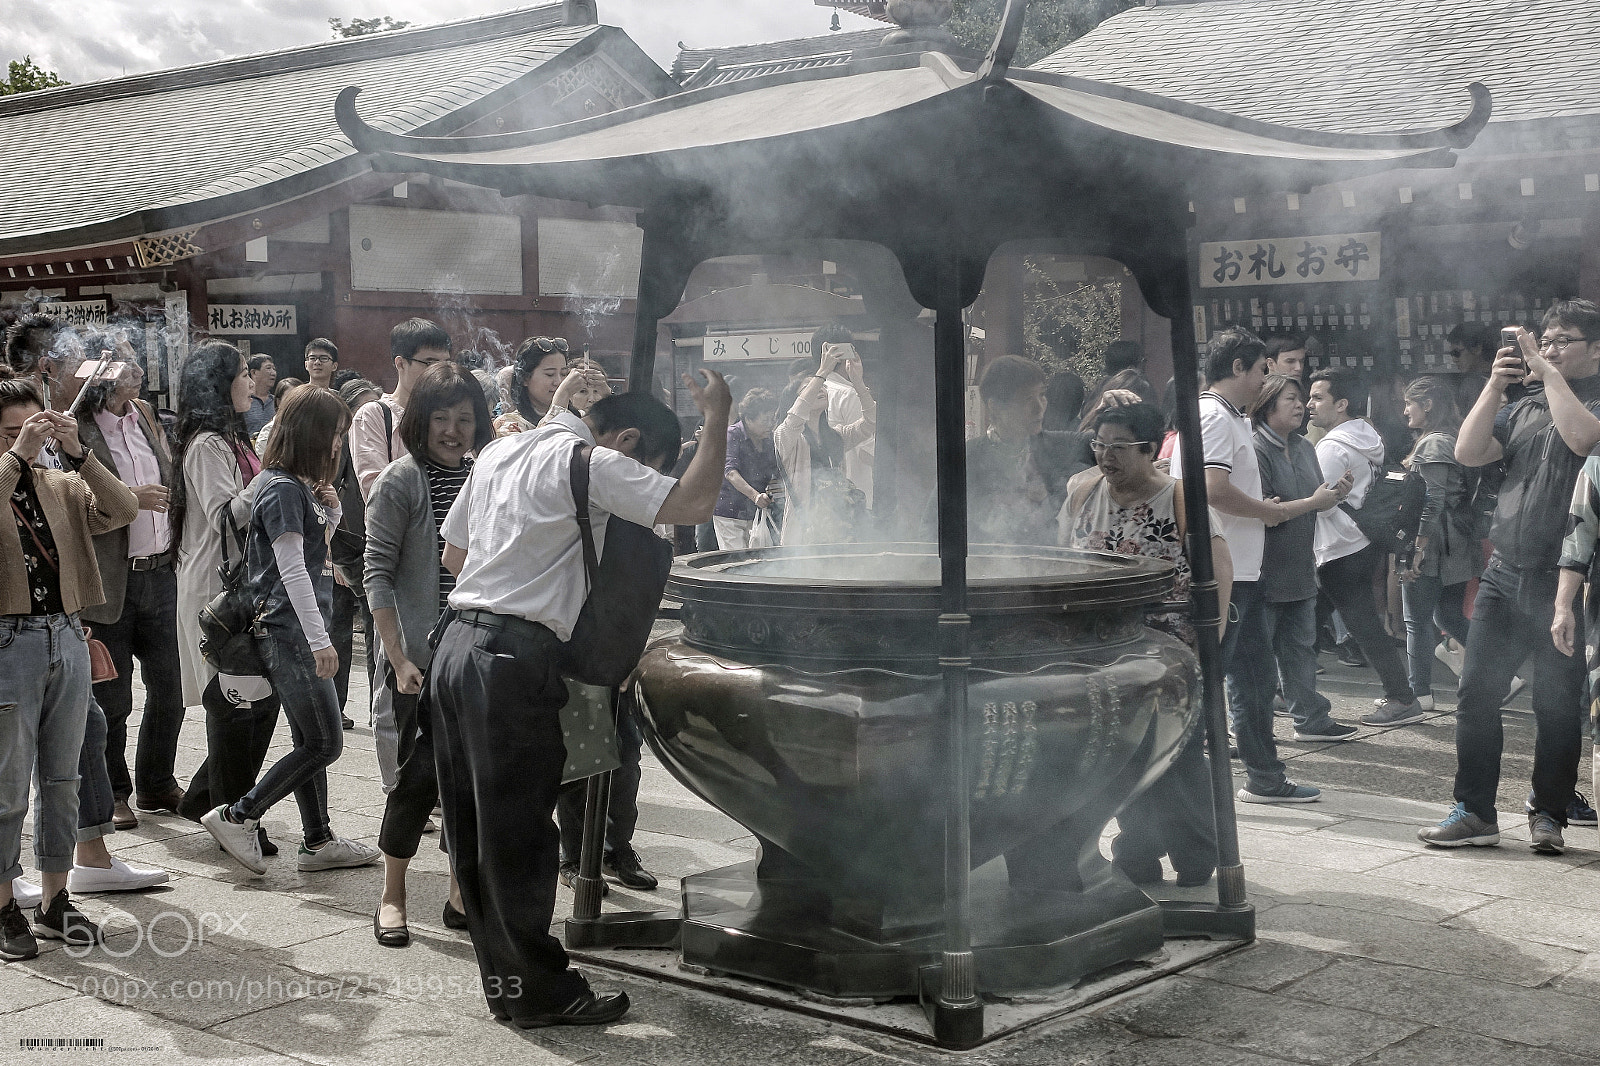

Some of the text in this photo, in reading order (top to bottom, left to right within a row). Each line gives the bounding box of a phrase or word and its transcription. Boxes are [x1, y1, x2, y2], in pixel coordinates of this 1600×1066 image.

[207, 308, 292, 330] 札お納め所
